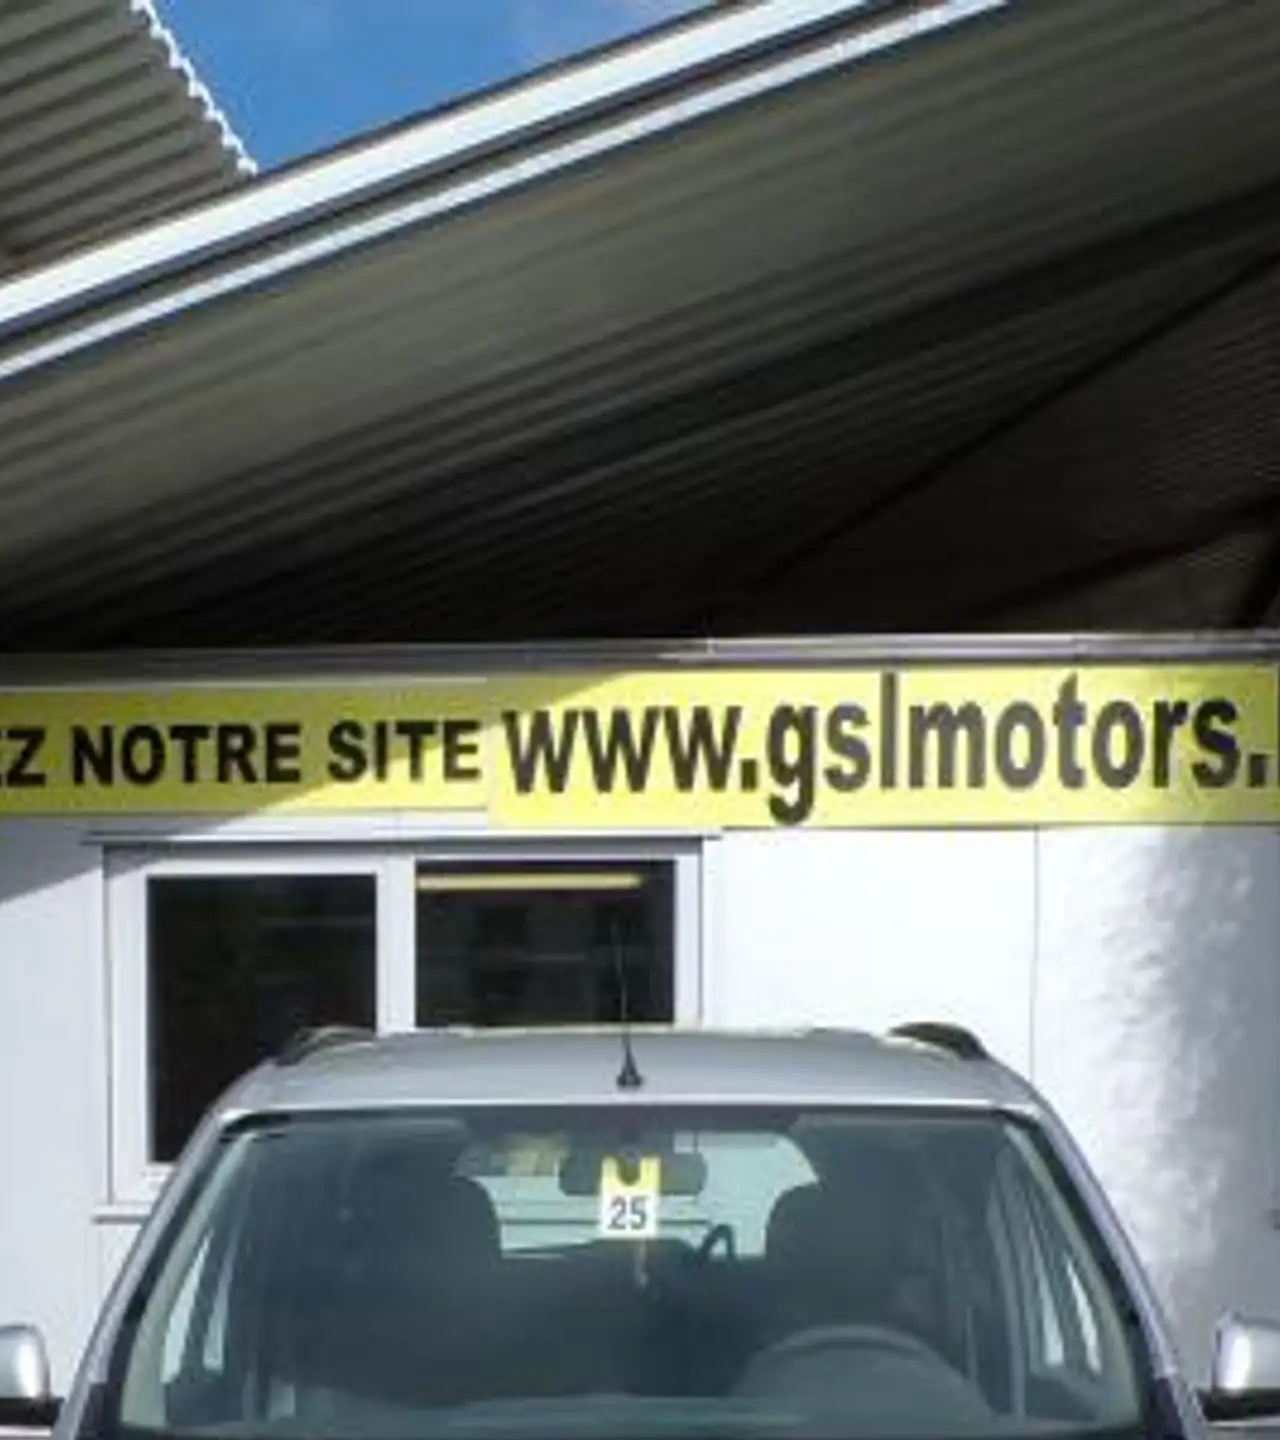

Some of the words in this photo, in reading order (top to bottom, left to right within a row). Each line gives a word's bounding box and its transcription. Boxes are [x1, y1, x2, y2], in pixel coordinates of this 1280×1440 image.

[72, 722, 302, 786] NOTRE
[326, 718, 483, 785] SITE
[607, 1195, 648, 1230] 25
